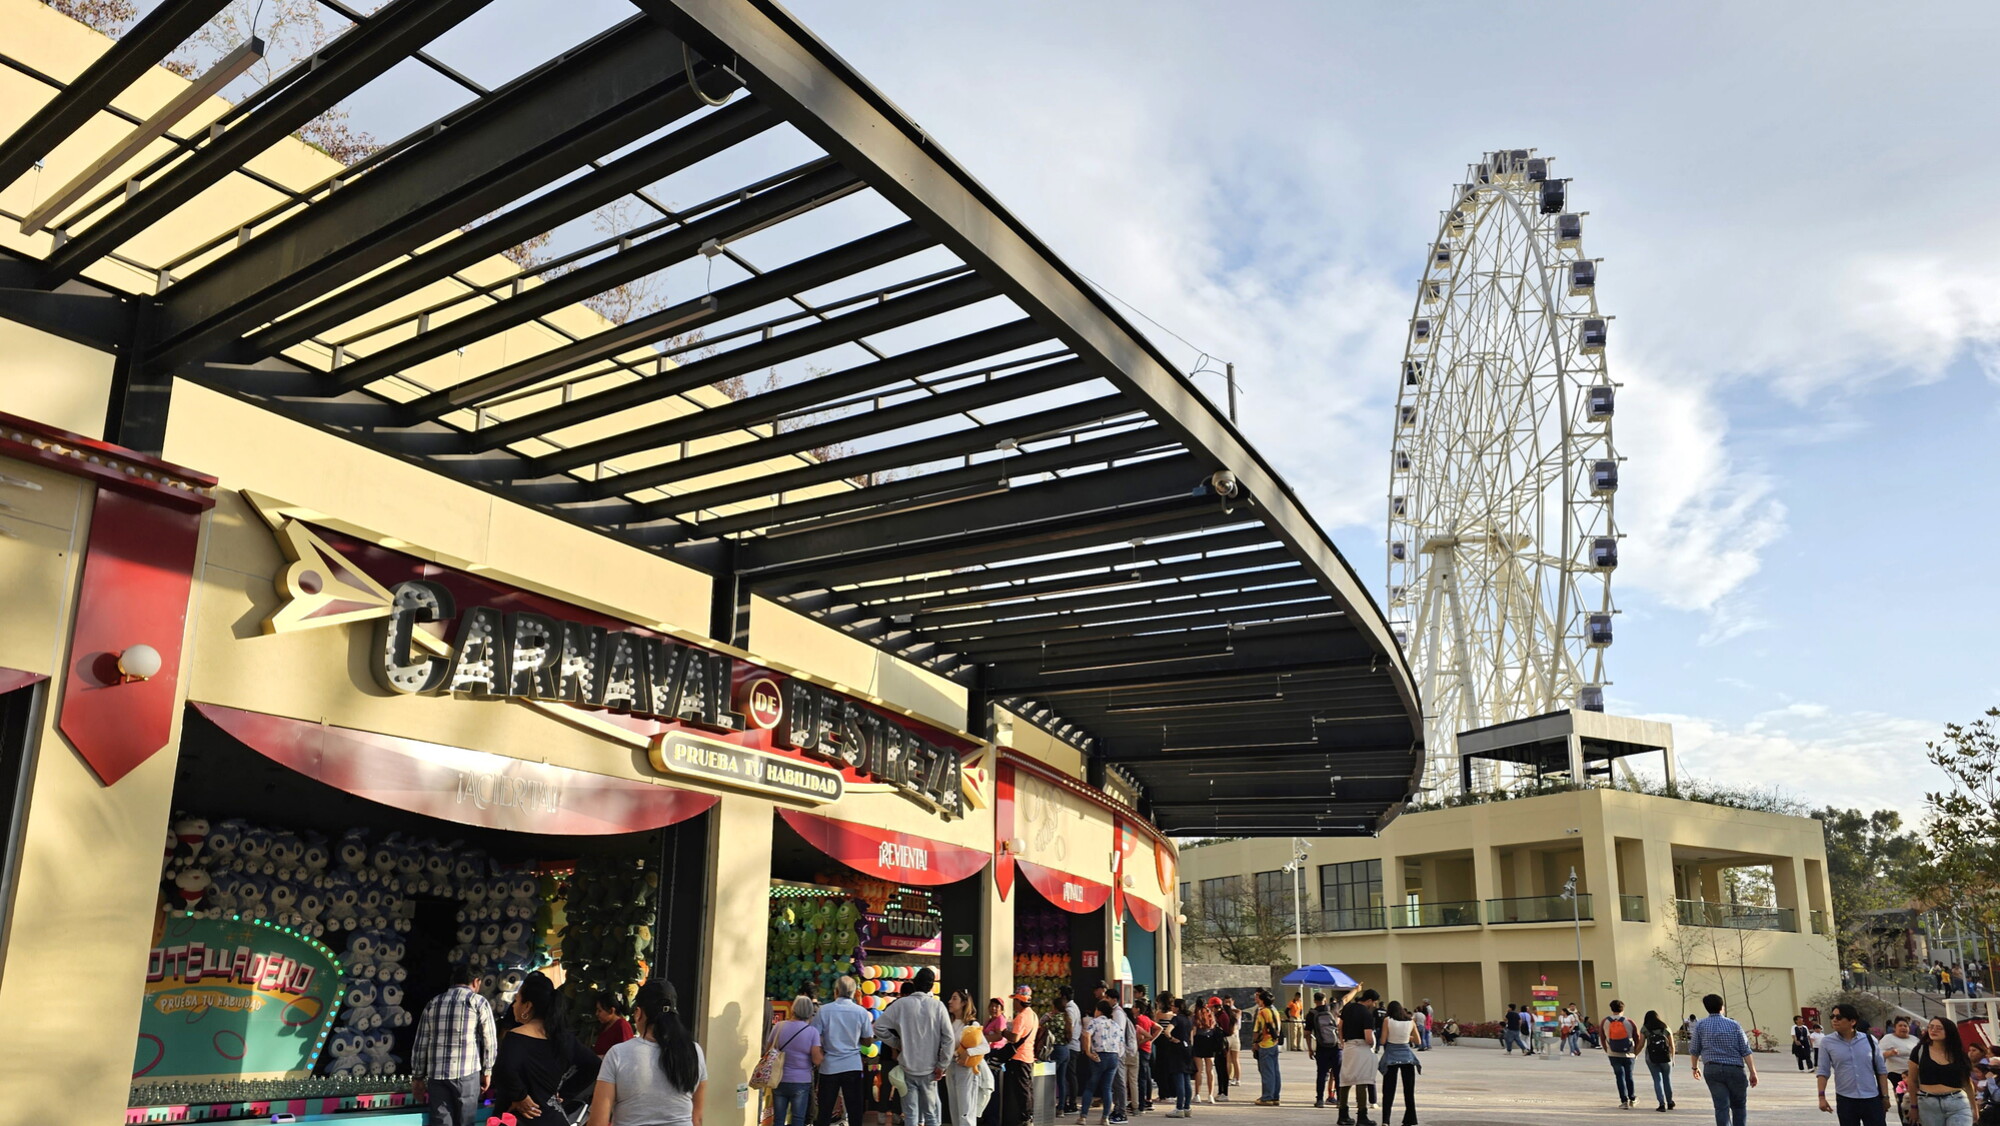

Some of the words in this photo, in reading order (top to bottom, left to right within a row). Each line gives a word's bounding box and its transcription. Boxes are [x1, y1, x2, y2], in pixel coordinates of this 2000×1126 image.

[384, 579, 746, 732] CARNAVAL
[754, 690, 778, 717] DE
[784, 679, 964, 821] DESTREZA
[673, 742, 739, 774] PRUEBA
[743, 757, 764, 779] TU
[766, 763, 837, 796] HABILIDAD
[455, 769, 560, 817] ¡ACIERTA!
[878, 840, 928, 872] ¡REVIENTA!
[888, 909, 941, 938] GLOBOS
[160, 994, 198, 1011] PRUEBA
[202, 995, 214, 1006] TU
[217, 995, 262, 1011] HABILIDAD
